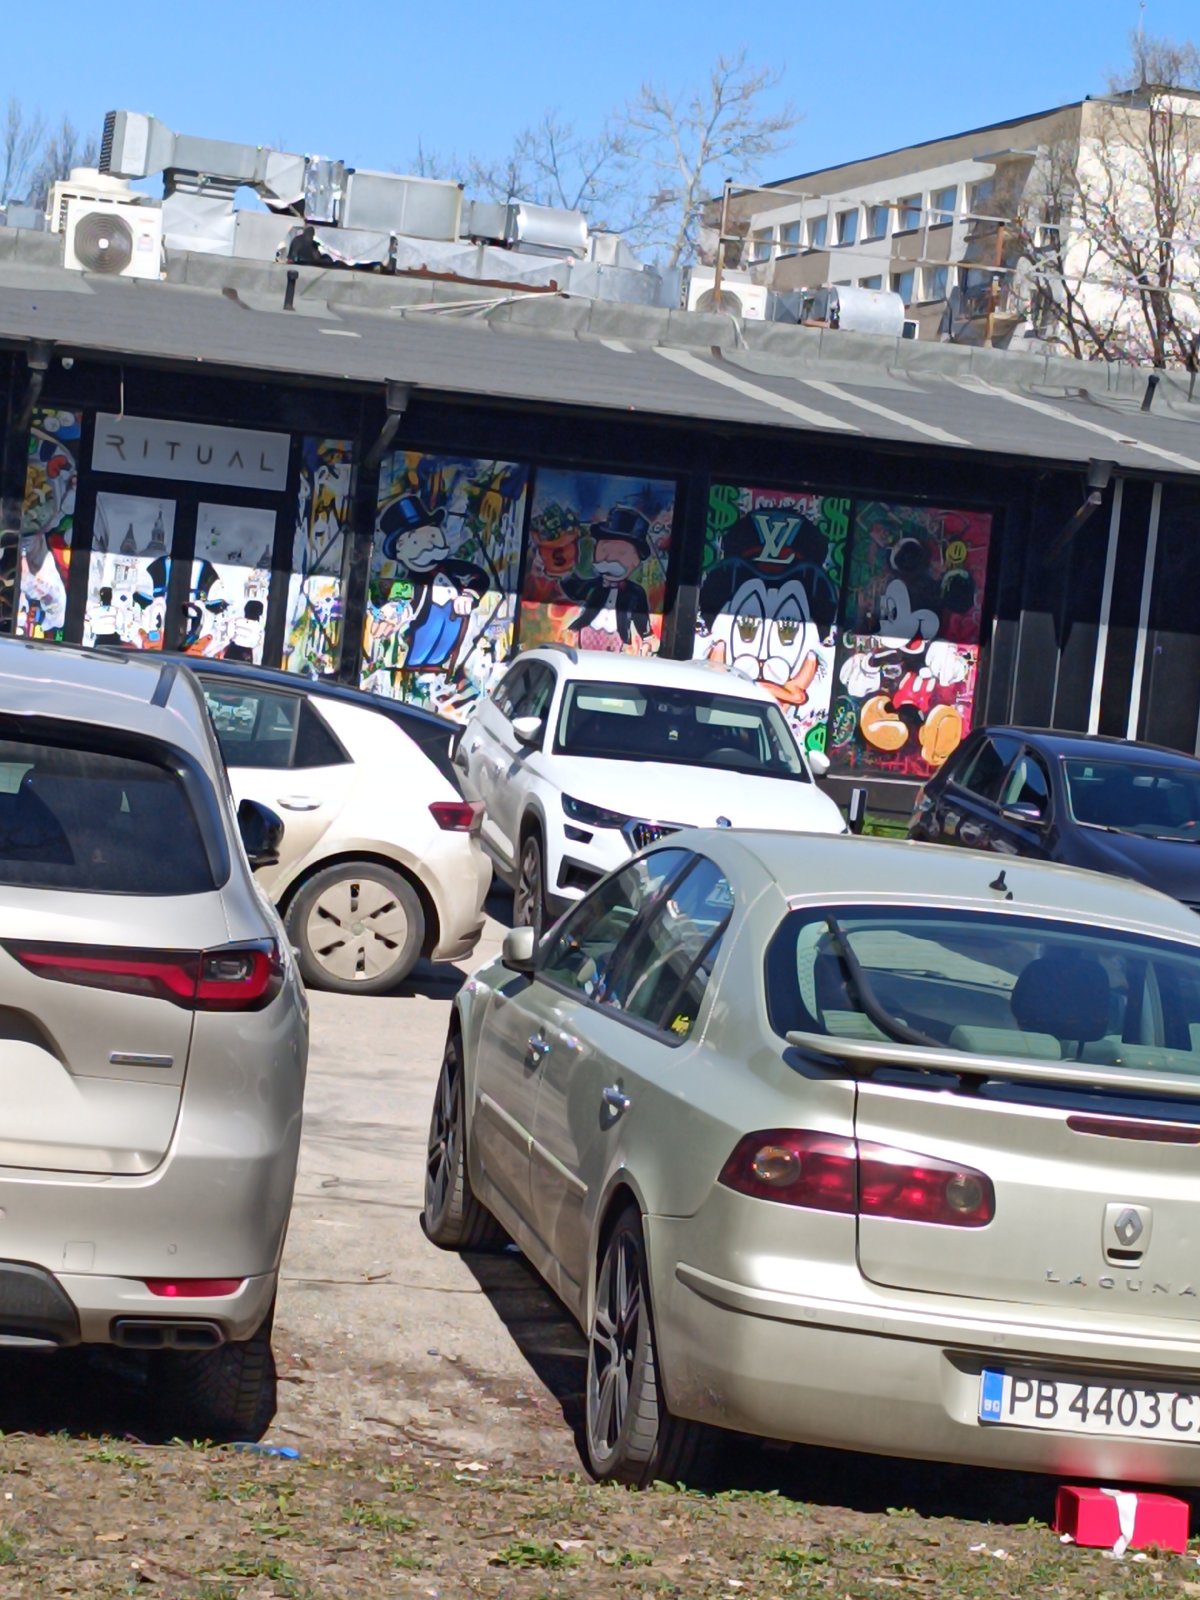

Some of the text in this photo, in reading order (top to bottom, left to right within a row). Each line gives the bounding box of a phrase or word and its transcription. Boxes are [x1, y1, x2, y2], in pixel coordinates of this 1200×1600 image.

[105, 434, 275, 472] RITUAL
[1046, 1269, 1197, 1297] LAGUNA
[1009, 1376, 1200, 1433] PB 4403 C
